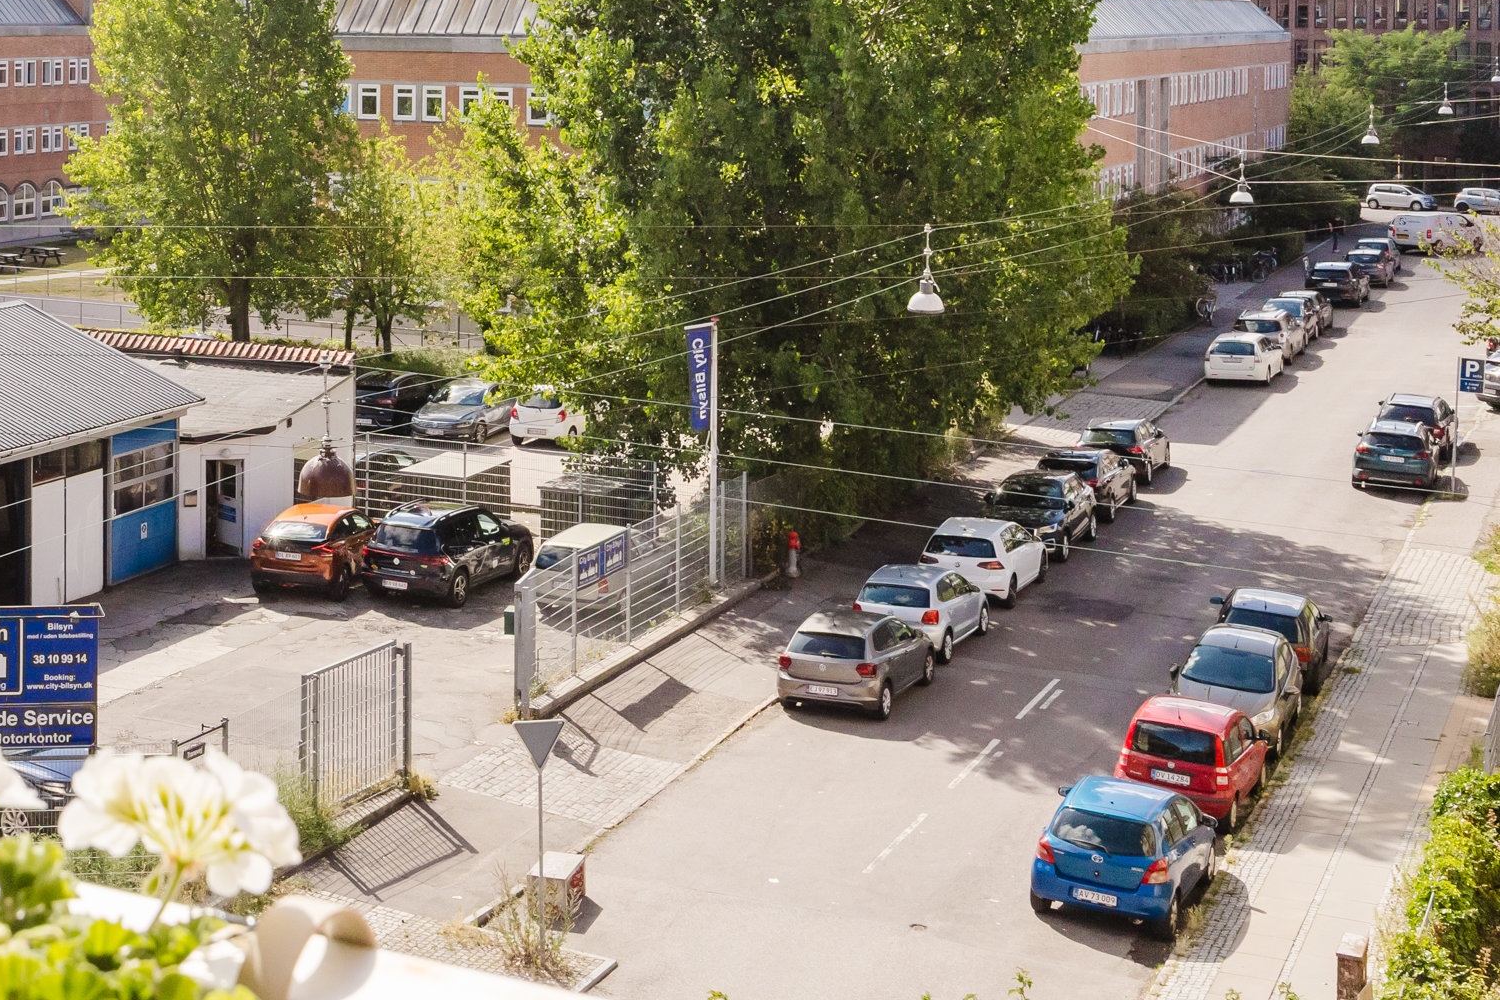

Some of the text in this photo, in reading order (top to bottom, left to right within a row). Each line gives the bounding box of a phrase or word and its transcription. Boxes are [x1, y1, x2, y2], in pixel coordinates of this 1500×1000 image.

[1465, 361, 1479, 377] P
[47, 622, 74, 632] Bilsyn
[32, 653, 88, 664] 38 10 99 14
[43, 673, 76, 682] Booking:
[26, 681, 93, 691] www.city-bilsyn.dk
[23, 709, 94, 726] Service
